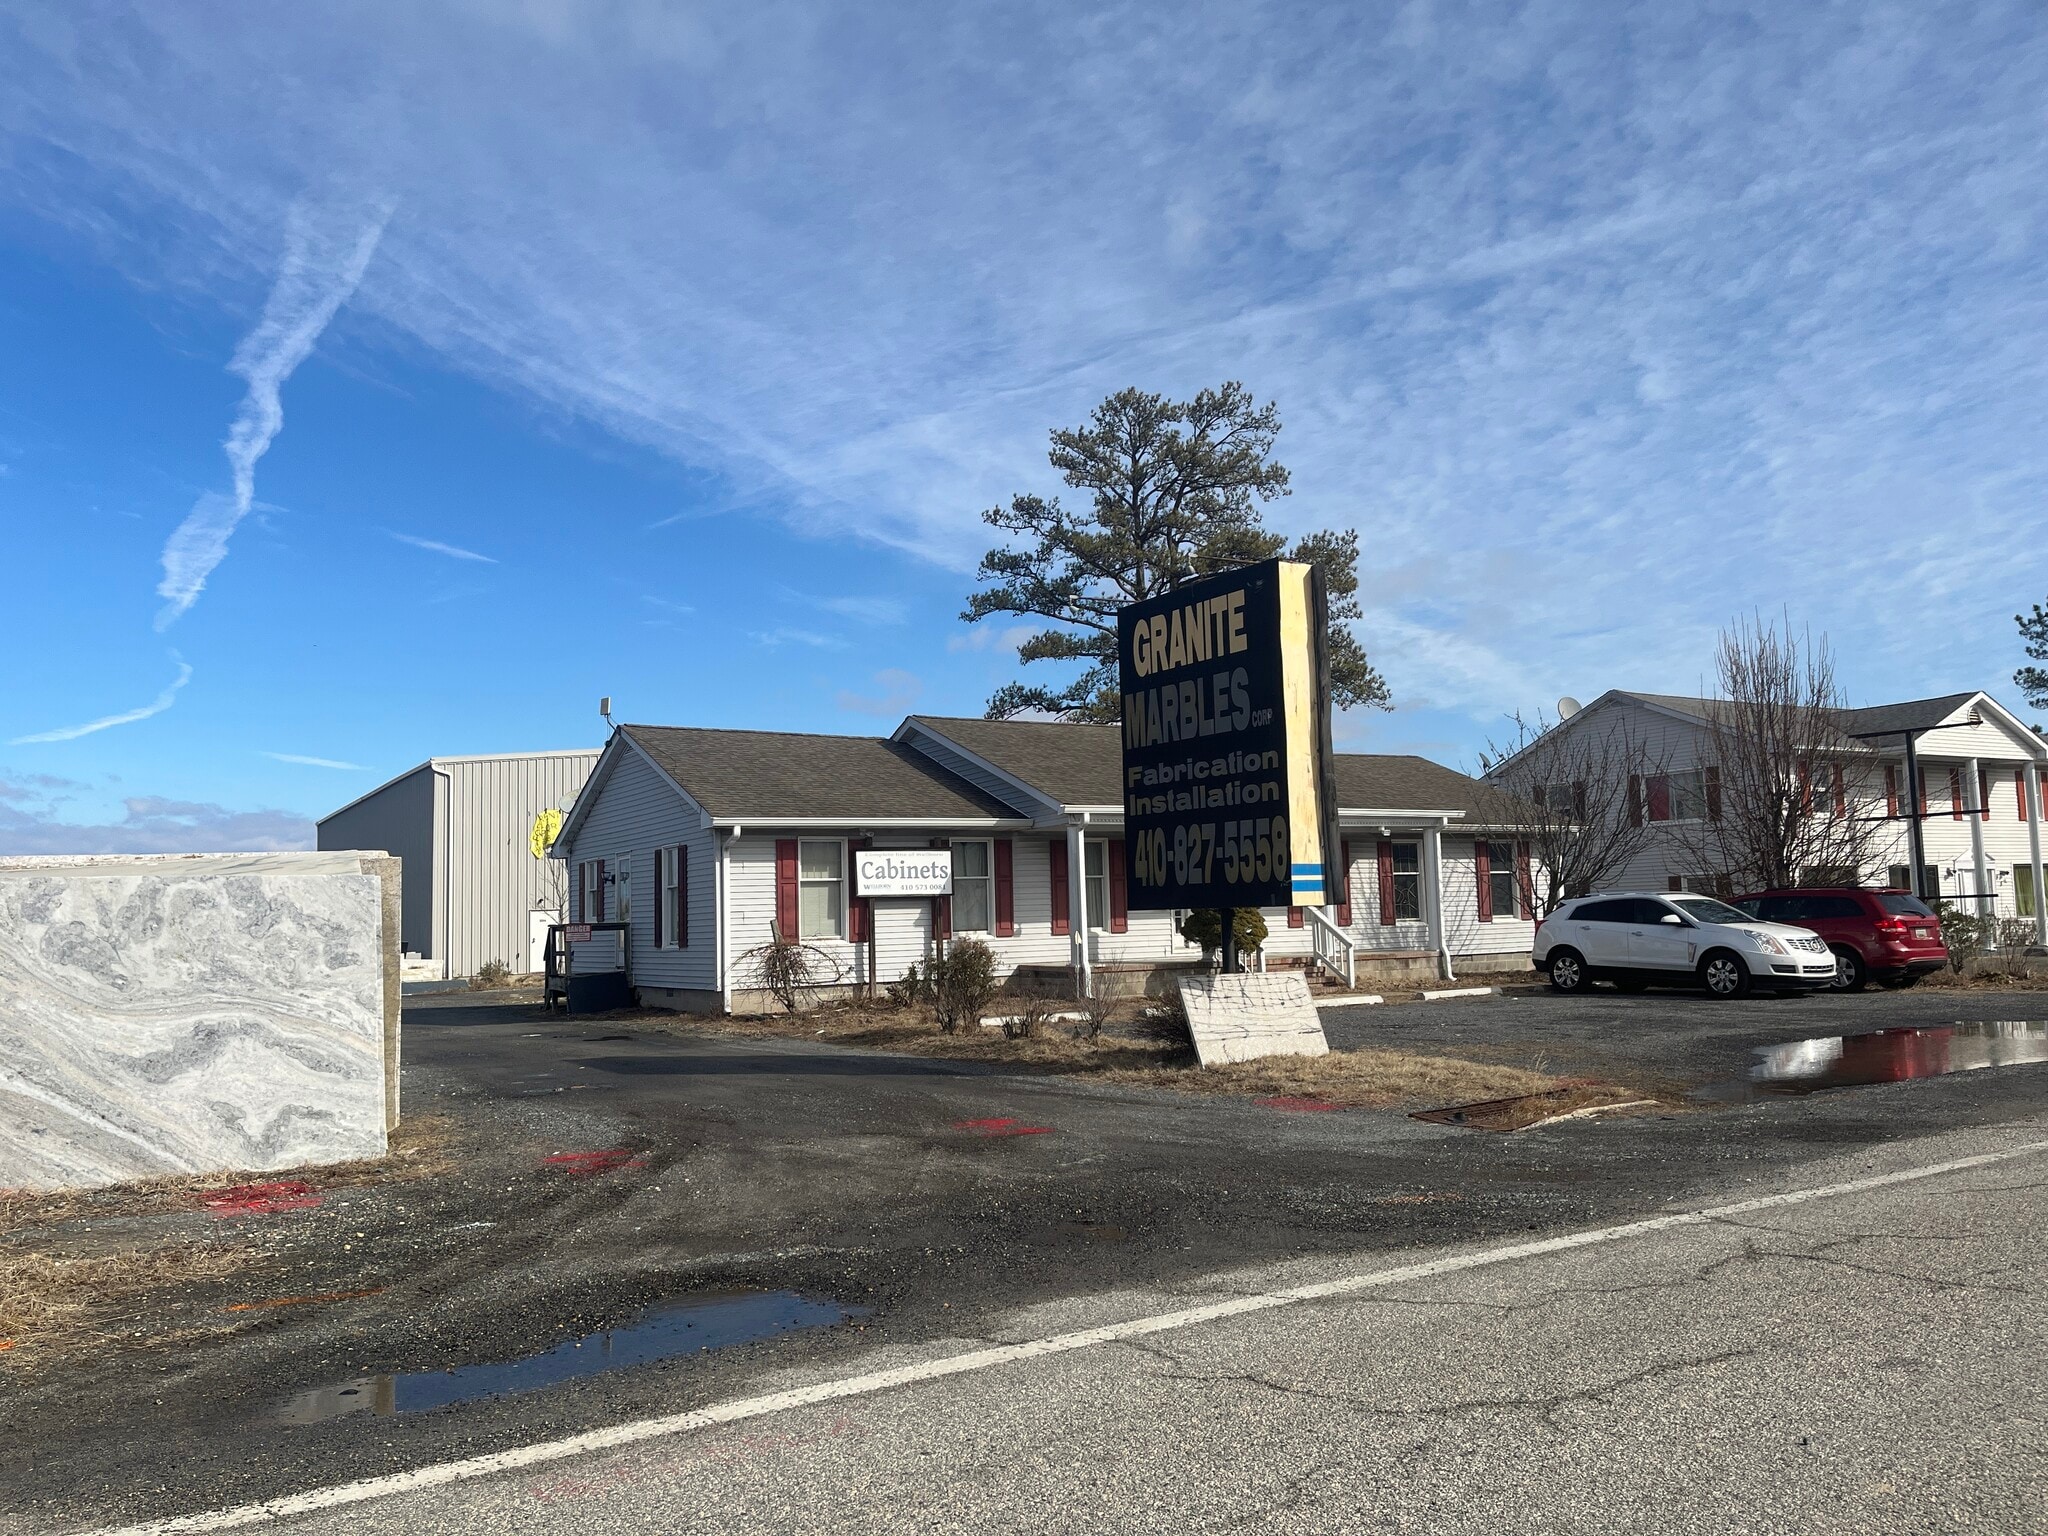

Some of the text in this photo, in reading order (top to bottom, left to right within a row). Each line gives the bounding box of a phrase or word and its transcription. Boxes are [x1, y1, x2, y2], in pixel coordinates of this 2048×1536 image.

[1133, 589, 1248, 677] GRANITE
[1125, 666, 1273, 750] MARBLES CORP
[1128, 750, 1279, 787] Fabrication
[1129, 779, 1280, 816] Installation
[862, 858, 948, 879] Cabinets
[1135, 816, 1287, 887] 410-827-5558
